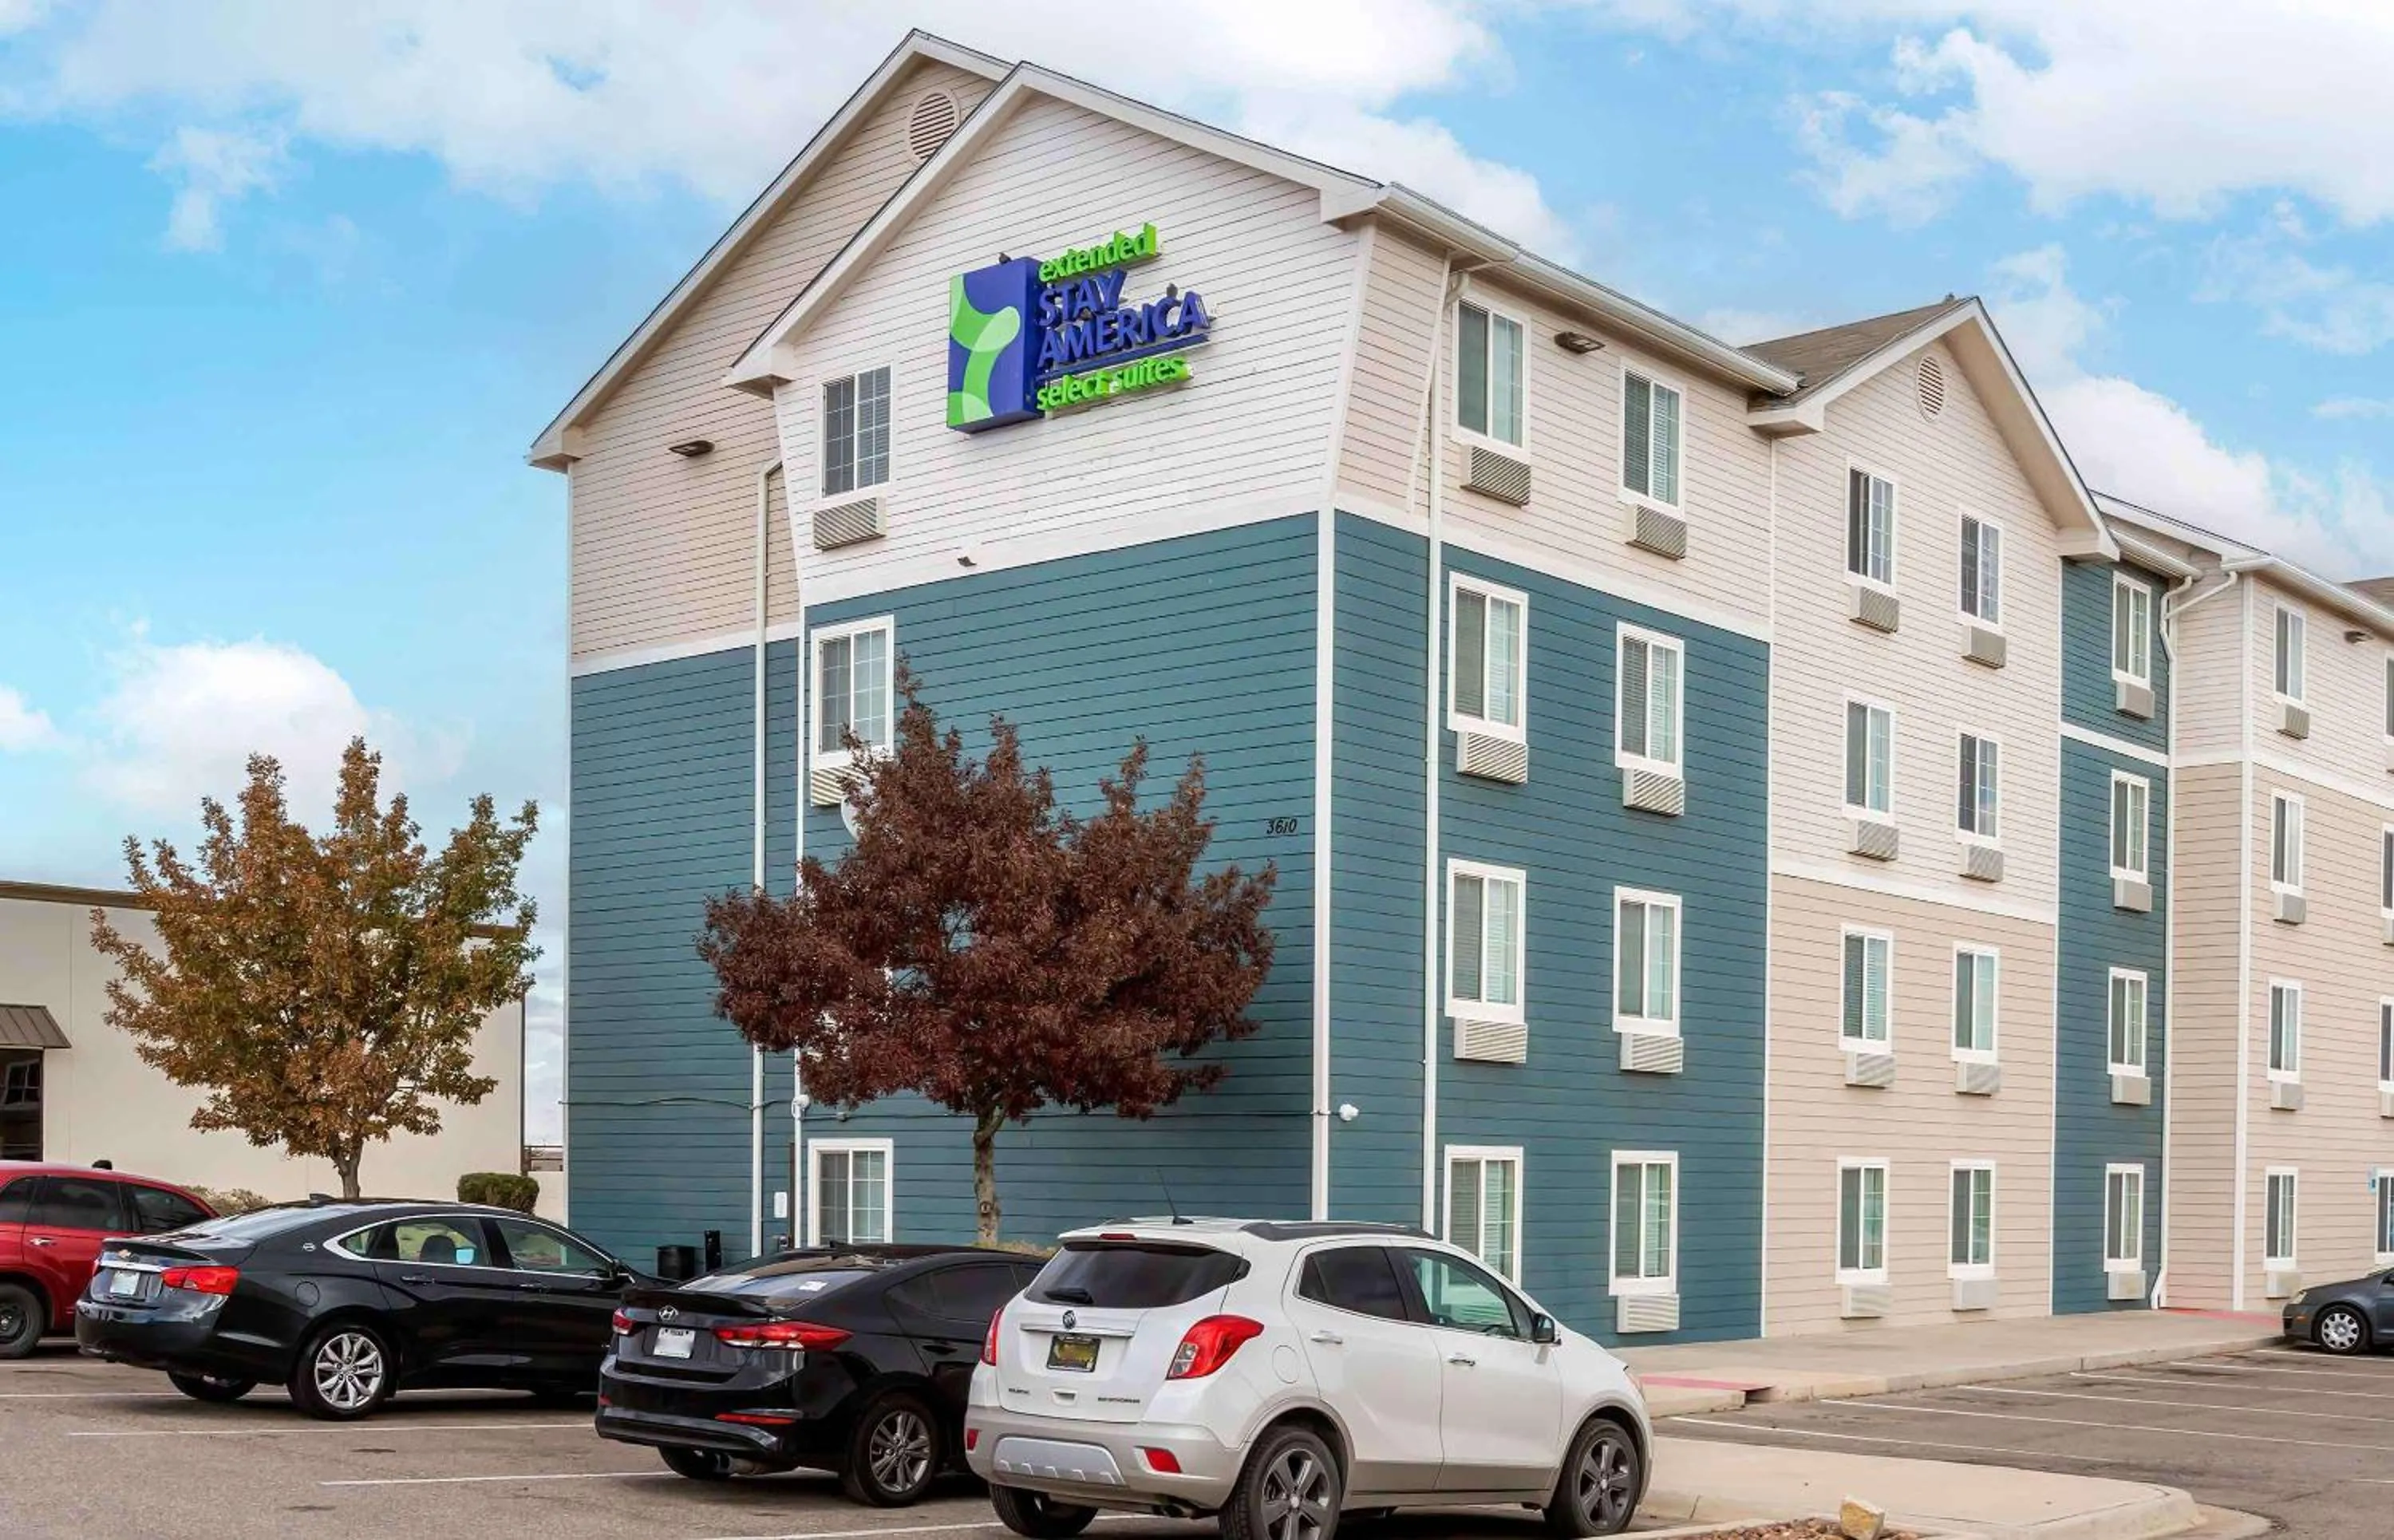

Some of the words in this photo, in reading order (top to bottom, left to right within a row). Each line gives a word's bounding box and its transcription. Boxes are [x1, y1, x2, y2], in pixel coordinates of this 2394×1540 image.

[1039, 223, 1156, 282] extended
[1040, 270, 1127, 326] STAY
[1038, 291, 1210, 367] AMERICA
[1037, 374, 1110, 410] select
[1114, 357, 1187, 392] suites
